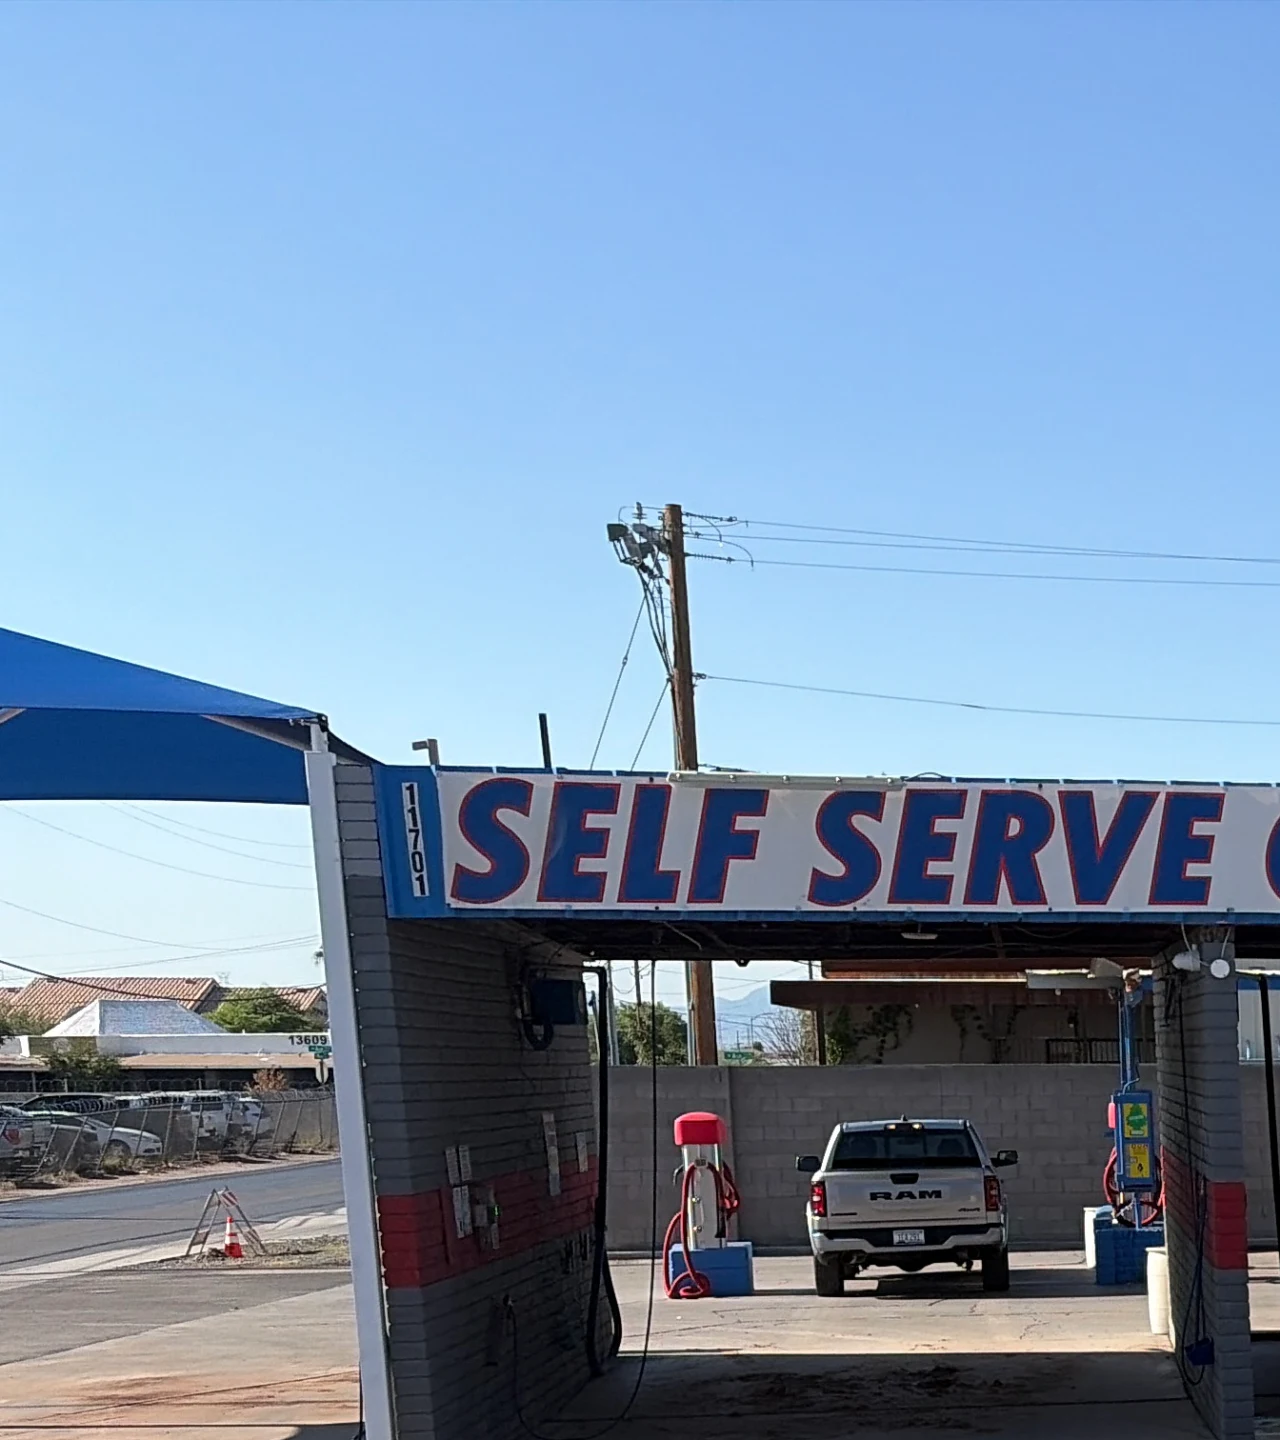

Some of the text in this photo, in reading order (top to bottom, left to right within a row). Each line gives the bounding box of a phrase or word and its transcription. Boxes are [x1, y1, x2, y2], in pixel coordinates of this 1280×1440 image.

[405, 783, 427, 896] 11701
[449, 777, 770, 904] SELF
[807, 788, 1226, 906] SERVE
[288, 1035, 328, 1046] 13609
[869, 1189, 942, 1201] RAM
